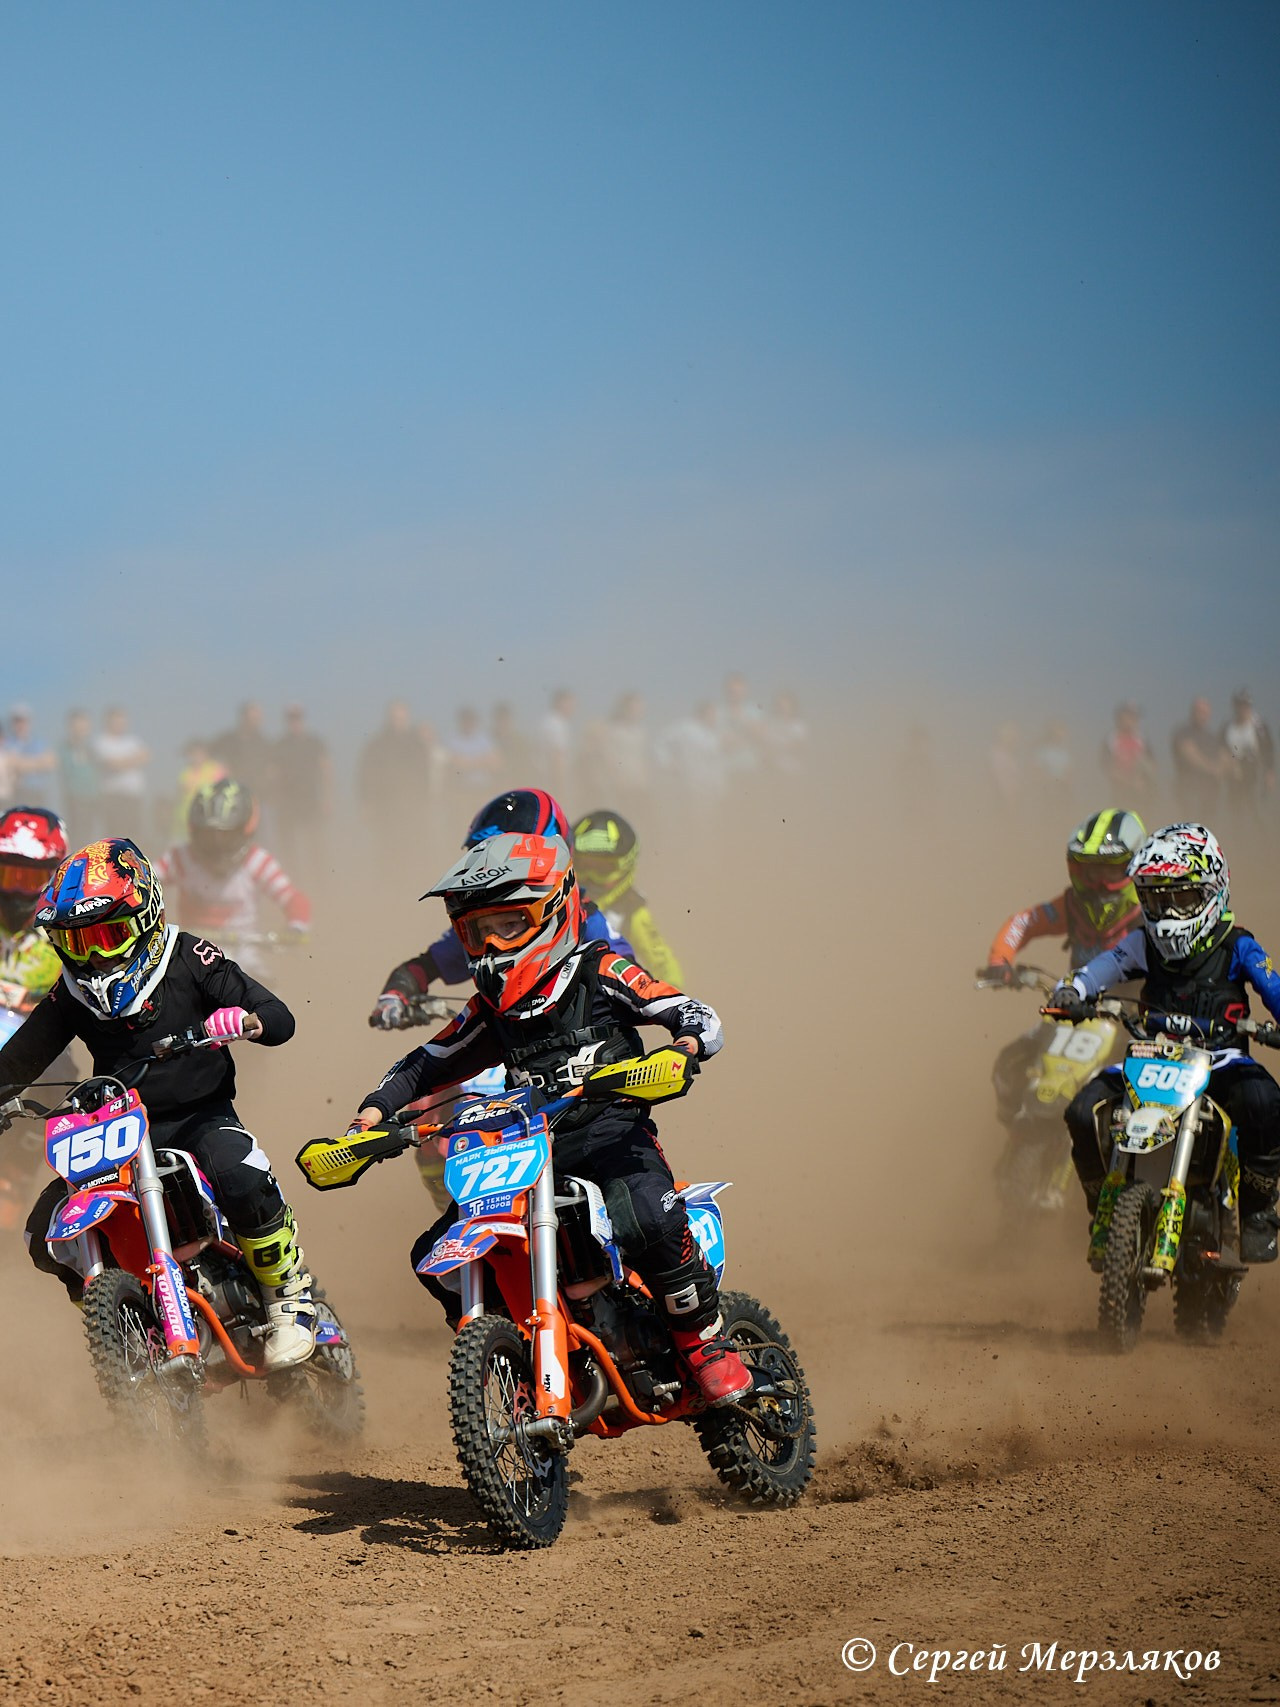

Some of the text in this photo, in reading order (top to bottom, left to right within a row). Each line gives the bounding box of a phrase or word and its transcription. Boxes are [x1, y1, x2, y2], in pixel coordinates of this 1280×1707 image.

[462, 865, 512, 887] AIROH
[138, 875, 162, 931] 100
[114, 986, 124, 1010] AIROH
[1047, 1025, 1104, 1063] 18
[52, 1115, 141, 1179] 150
[87, 1172, 119, 1189] MOTOREX
[458, 1150, 537, 1200] 727
[486, 1194, 511, 1205] ТЕХНО
[486, 1200, 511, 1211] ГОРОД
[171, 1267, 192, 1319] MOTOREX
